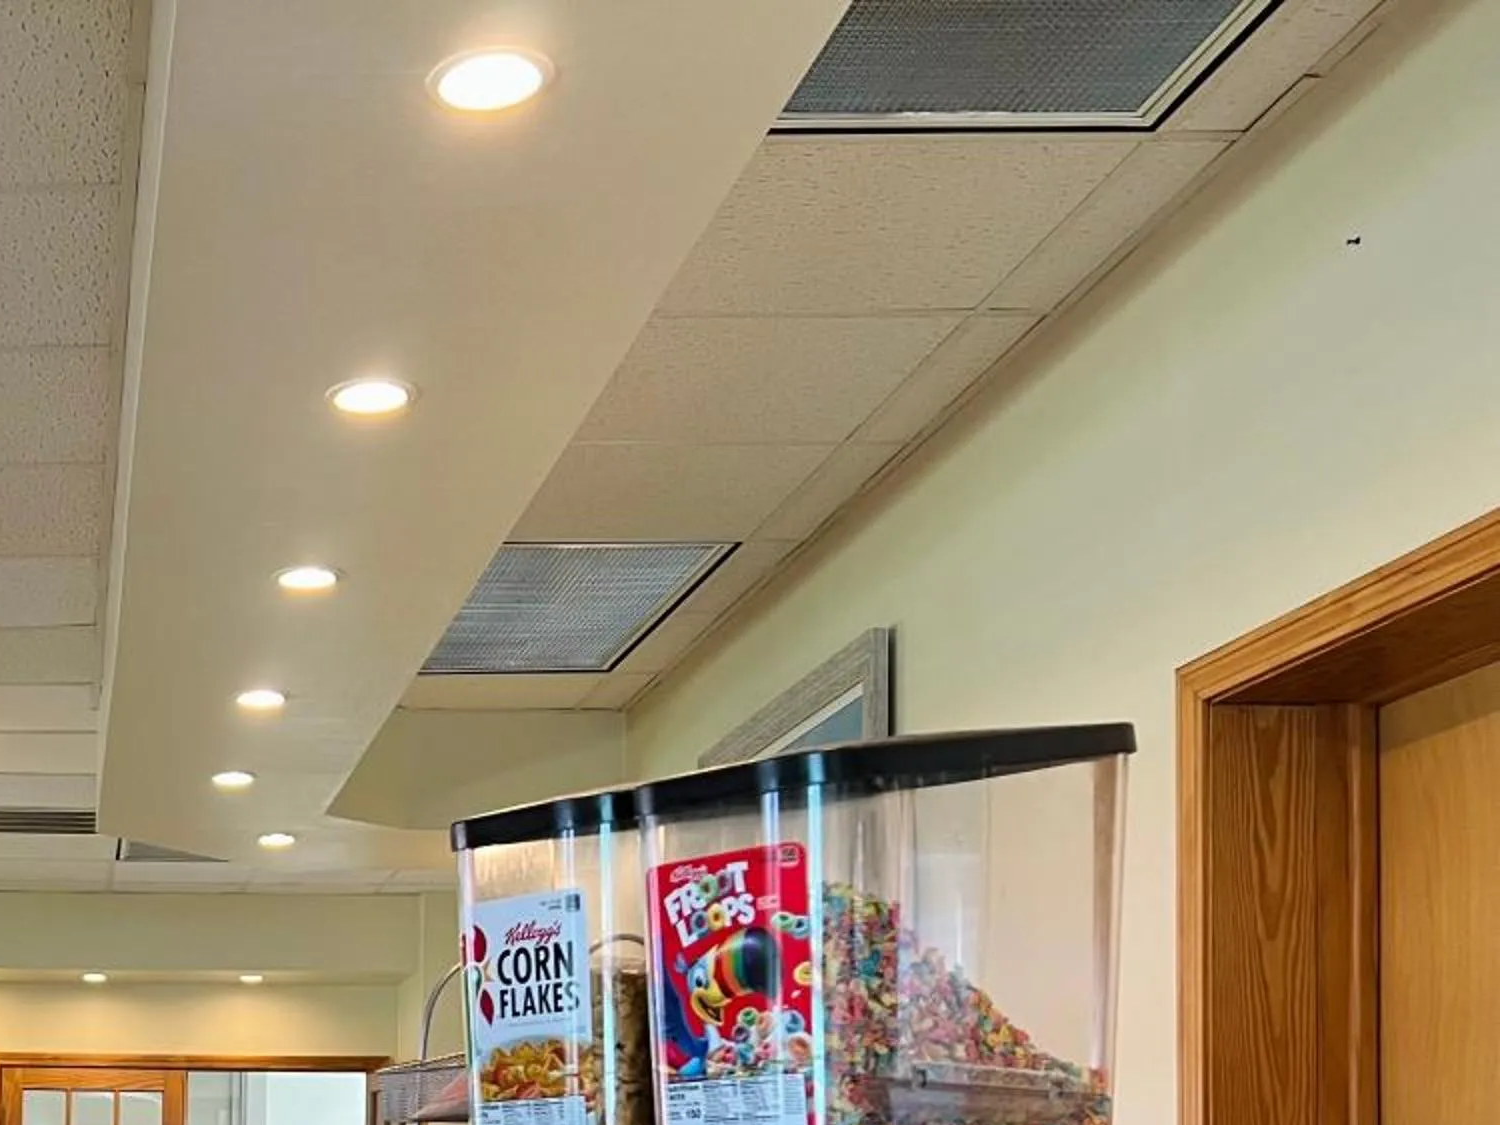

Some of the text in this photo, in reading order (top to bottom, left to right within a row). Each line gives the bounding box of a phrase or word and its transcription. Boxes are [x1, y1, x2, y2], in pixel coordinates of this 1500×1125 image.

[664, 861, 749, 925] FROOT
[675, 893, 756, 948] LOOPS
[497, 940, 573, 985] CORN
[499, 981, 580, 1019] FLAKES
